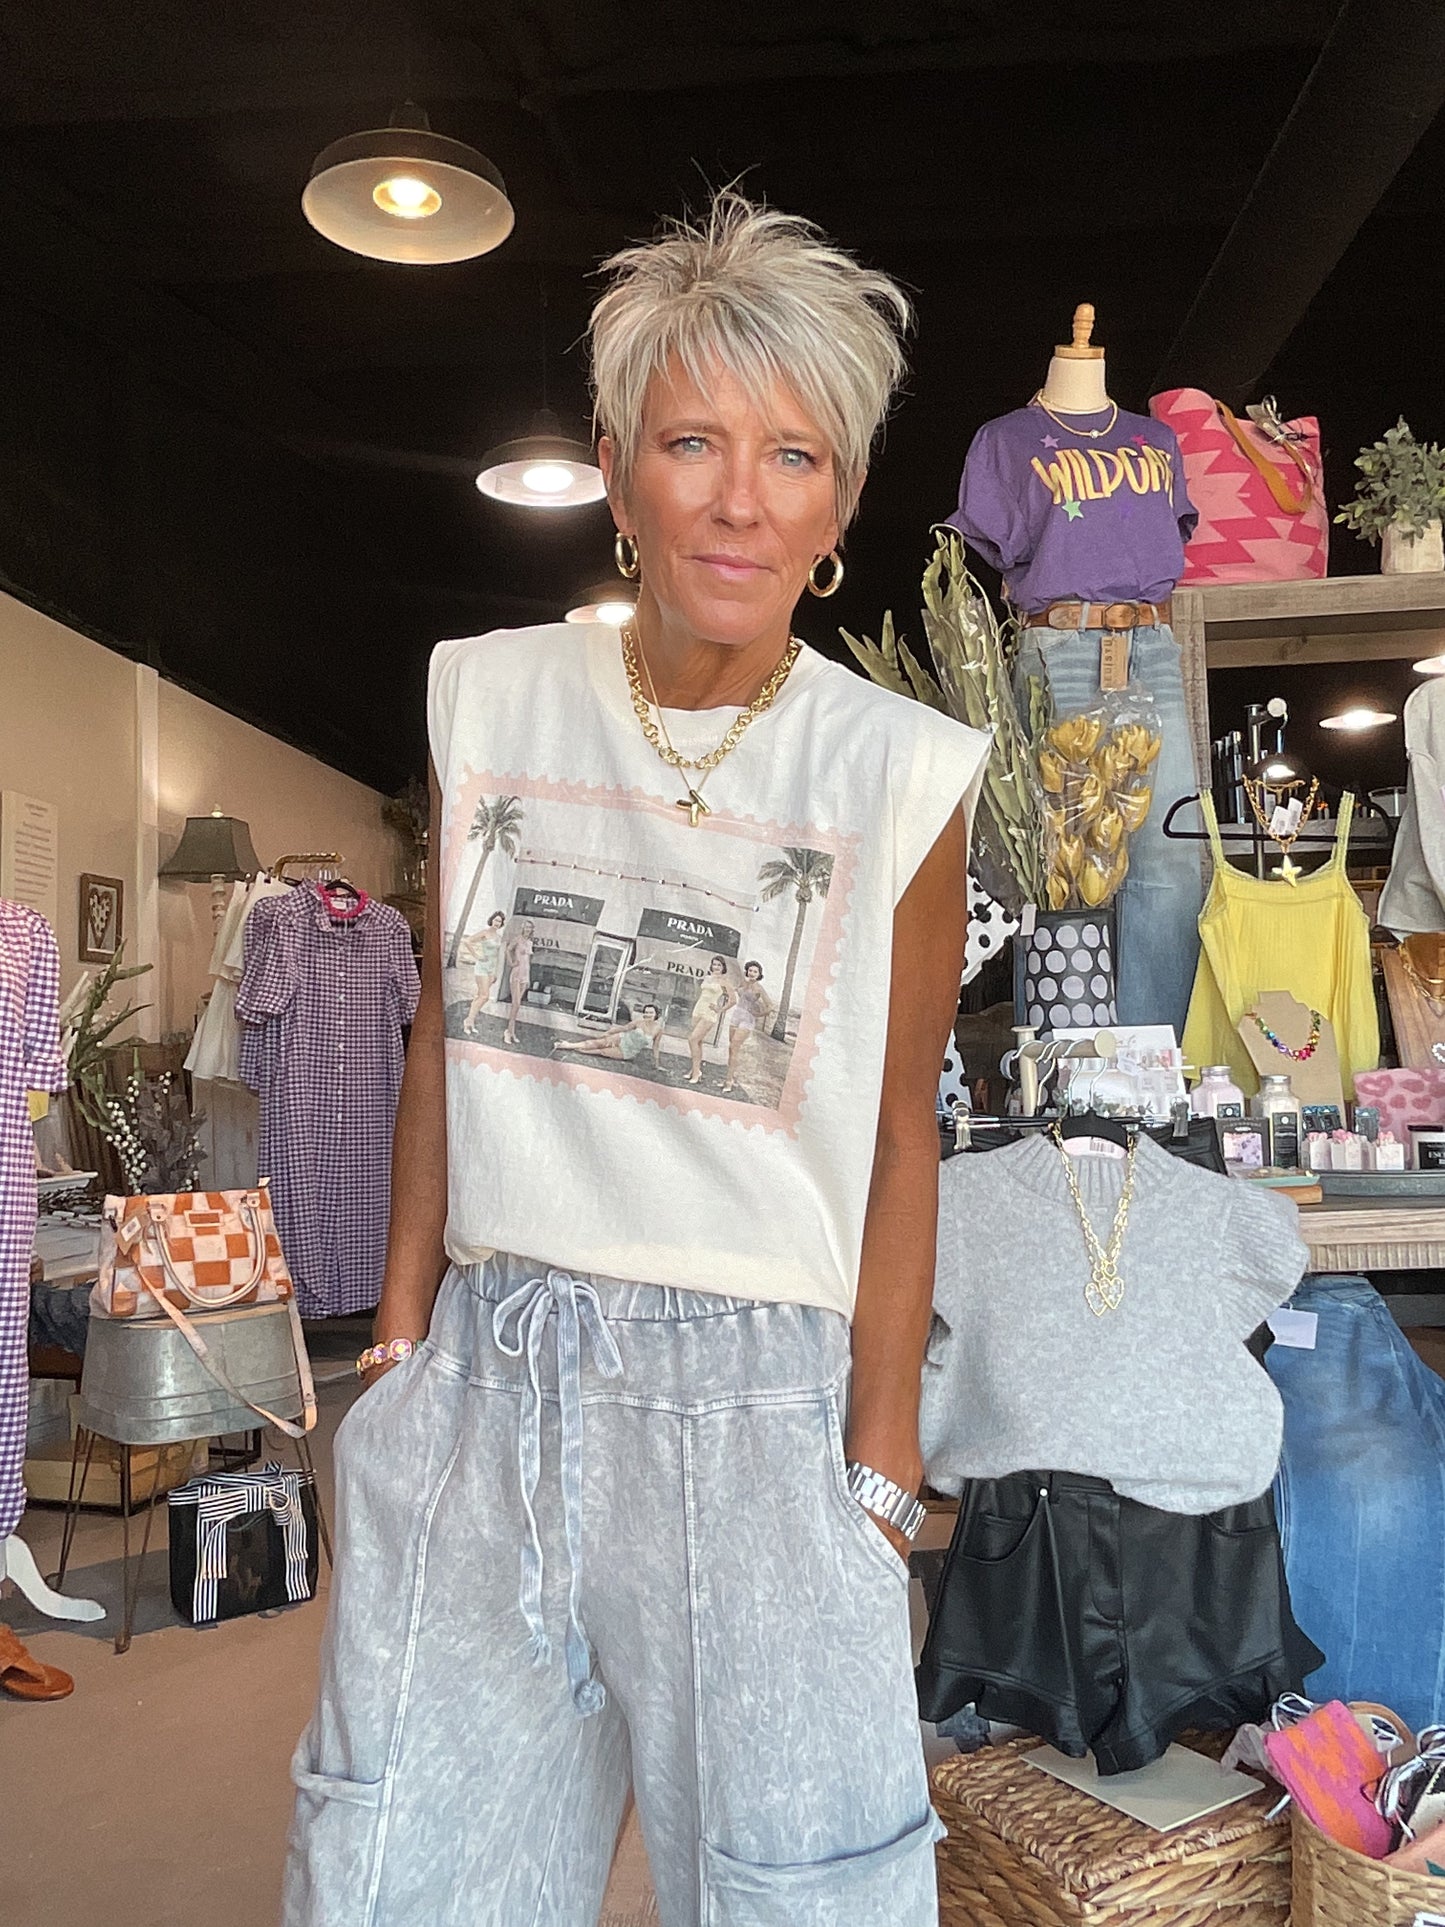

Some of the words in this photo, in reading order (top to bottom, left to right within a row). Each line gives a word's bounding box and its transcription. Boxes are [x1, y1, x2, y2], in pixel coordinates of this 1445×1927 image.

[533, 894, 574, 909] PRADA
[667, 917, 714, 938] PRADA
[530, 937, 560, 949] RADA
